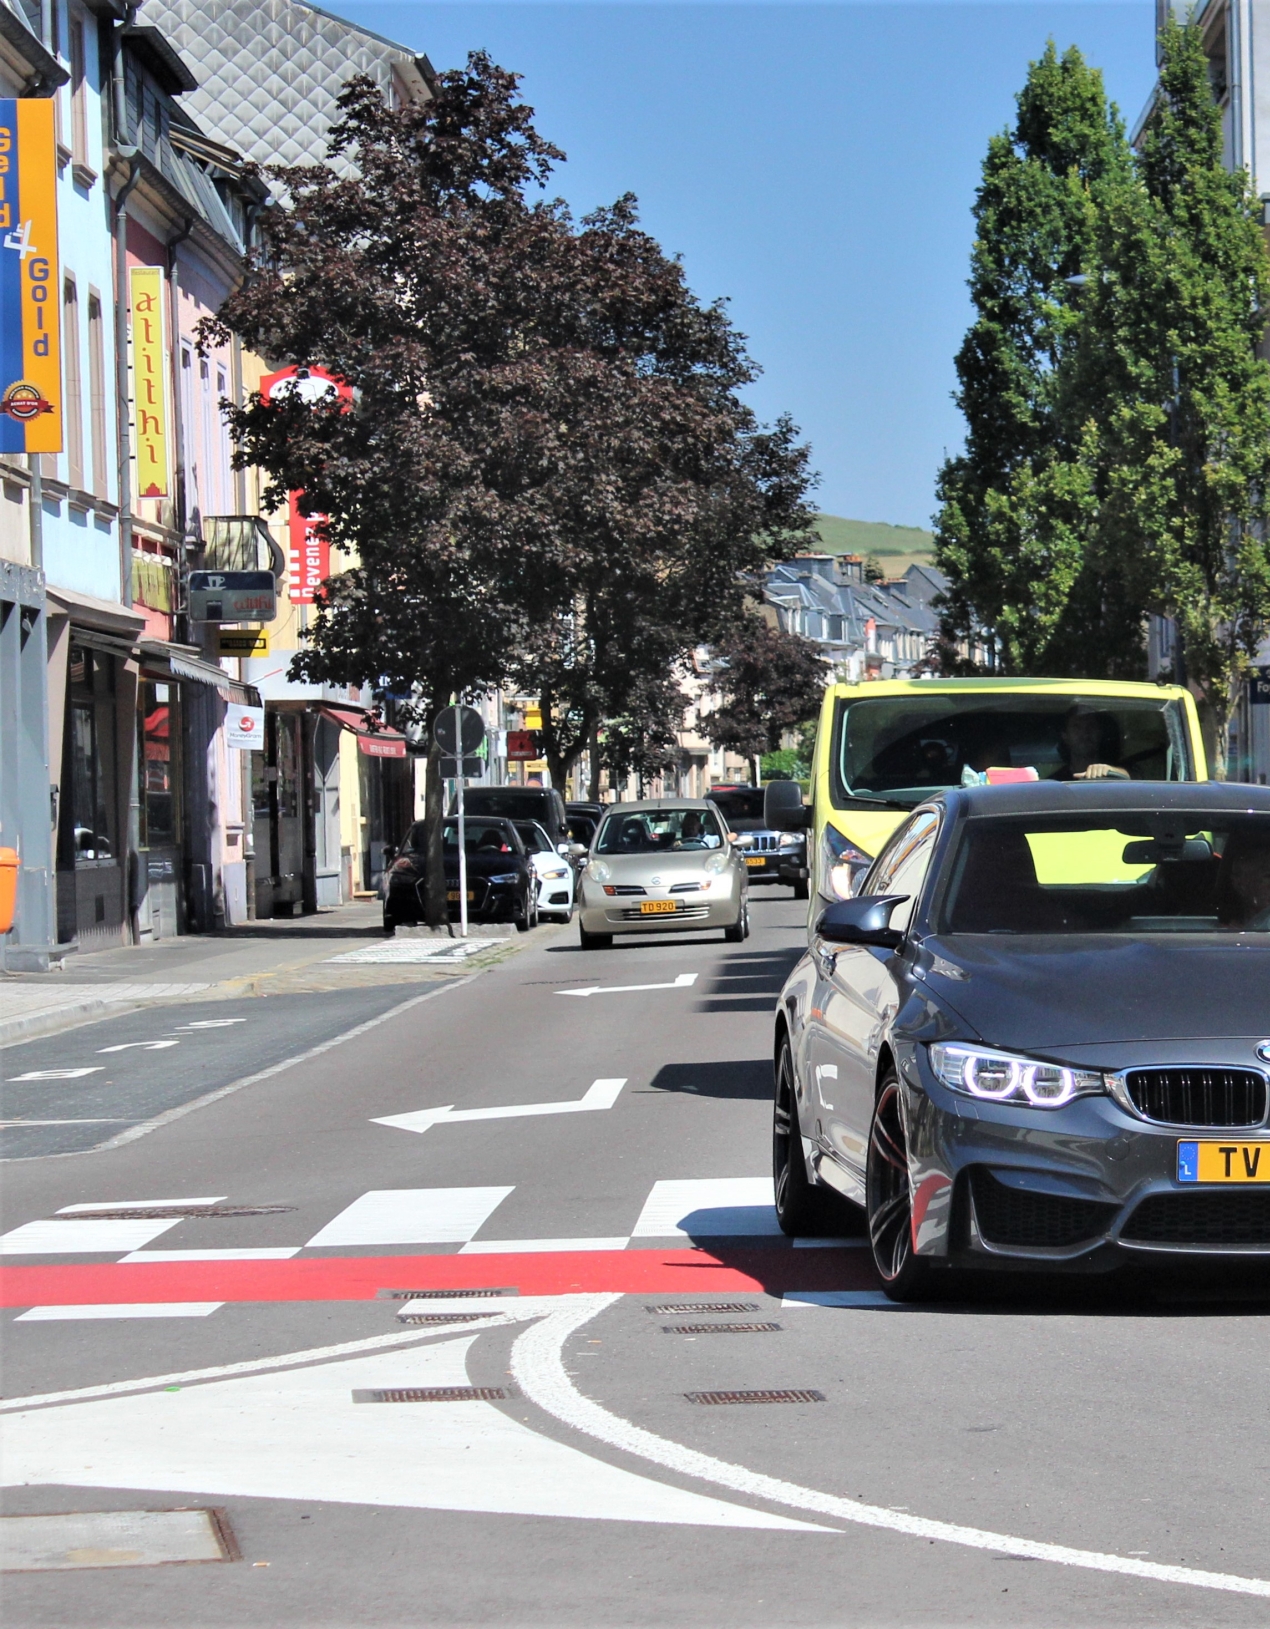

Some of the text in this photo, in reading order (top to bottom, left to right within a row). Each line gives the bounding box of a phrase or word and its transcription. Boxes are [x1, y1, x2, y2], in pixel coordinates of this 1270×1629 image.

[28, 257, 49, 356] Gold
[135, 292, 163, 464] atithi
[229, 732, 262, 740] MoneyGram
[642, 902, 674, 911] TD 920
[1184, 1165, 1191, 1175] L
[1219, 1147, 1261, 1177] TV
